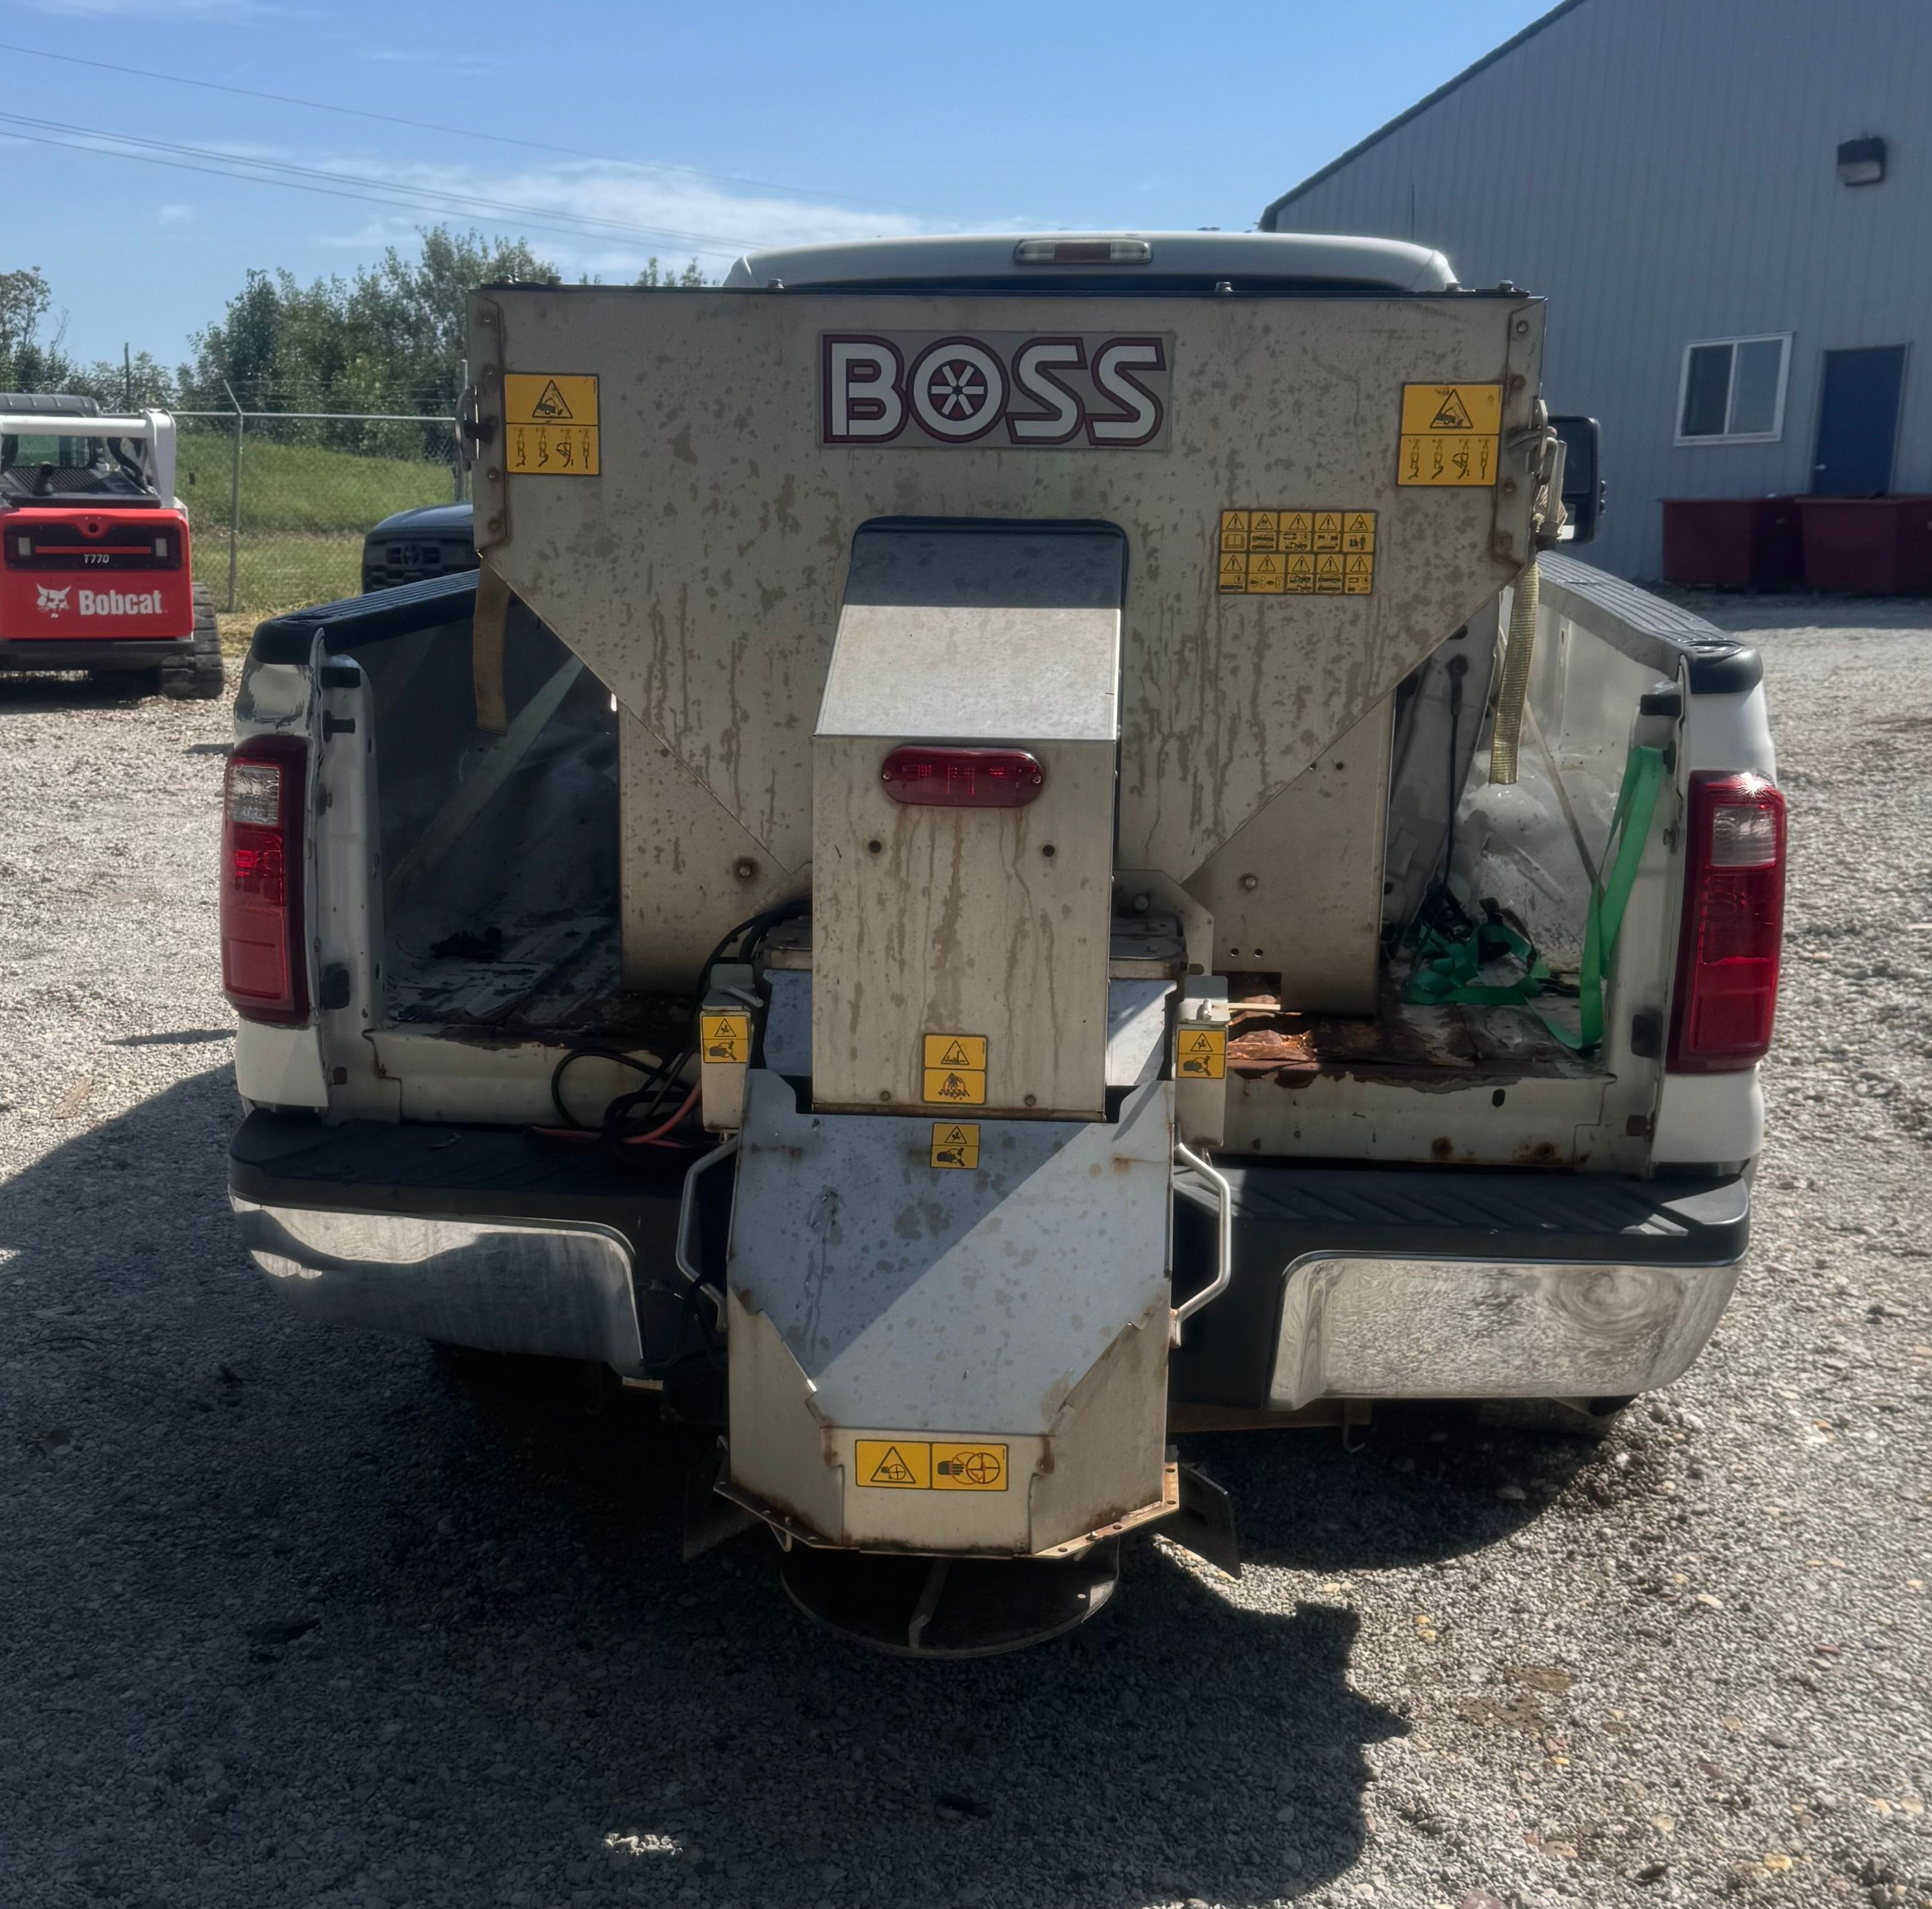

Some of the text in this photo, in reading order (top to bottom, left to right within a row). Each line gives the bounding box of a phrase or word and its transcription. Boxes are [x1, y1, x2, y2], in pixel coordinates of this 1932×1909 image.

[823, 335, 1166, 446] BOSS
[84, 554, 110, 564] T770
[79, 589, 163, 615] Bobcat
